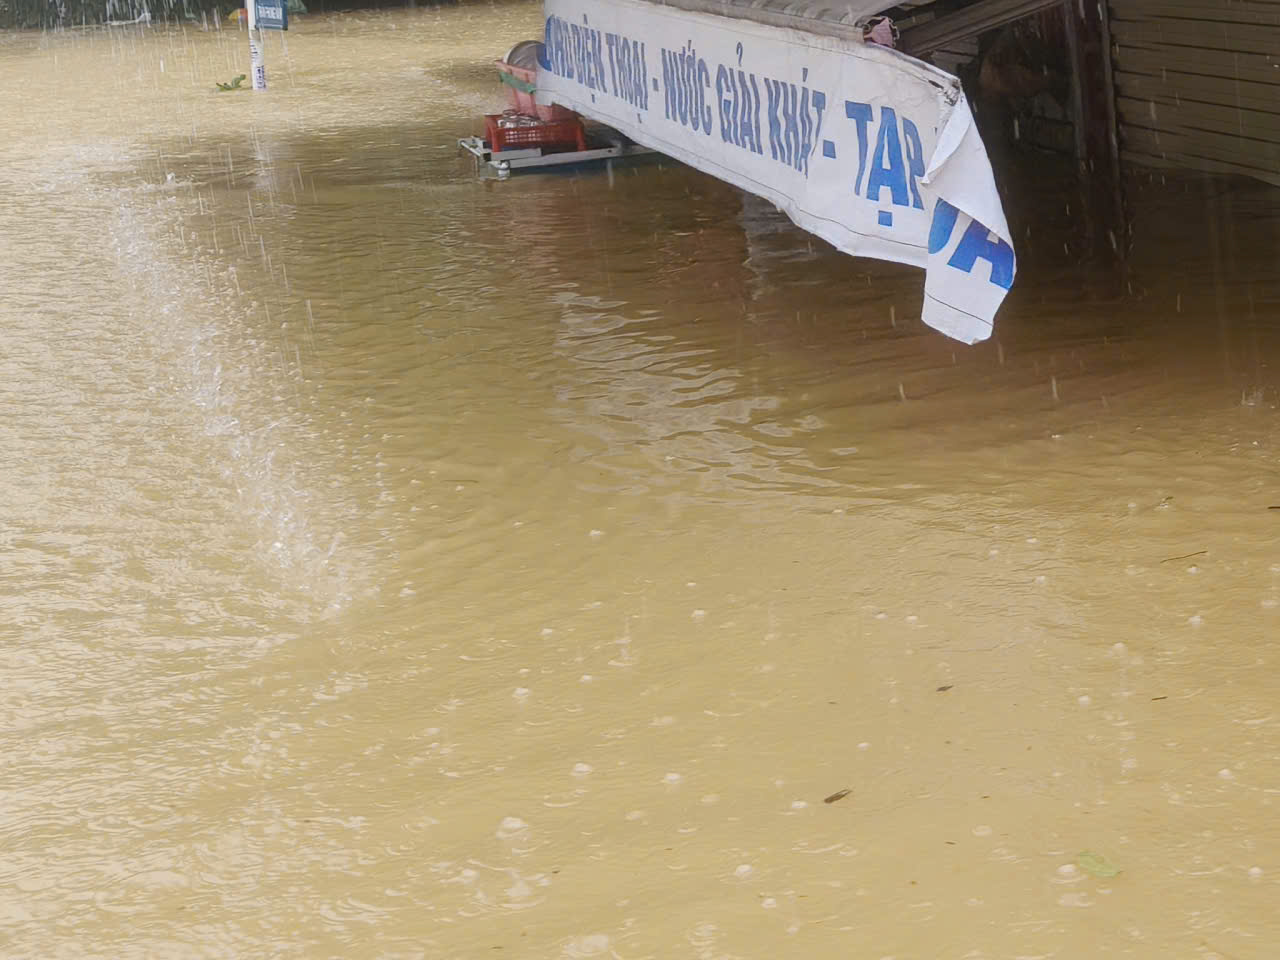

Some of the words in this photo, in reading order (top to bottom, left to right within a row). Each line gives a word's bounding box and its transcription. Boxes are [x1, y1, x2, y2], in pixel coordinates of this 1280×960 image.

[606, 32, 648, 124] THOẠI
[661, 39, 712, 136] NƯỚC
[716, 41, 763, 155] GIẢI
[763, 67, 826, 179] KHÁT
[845, 100, 926, 227] TẠP
